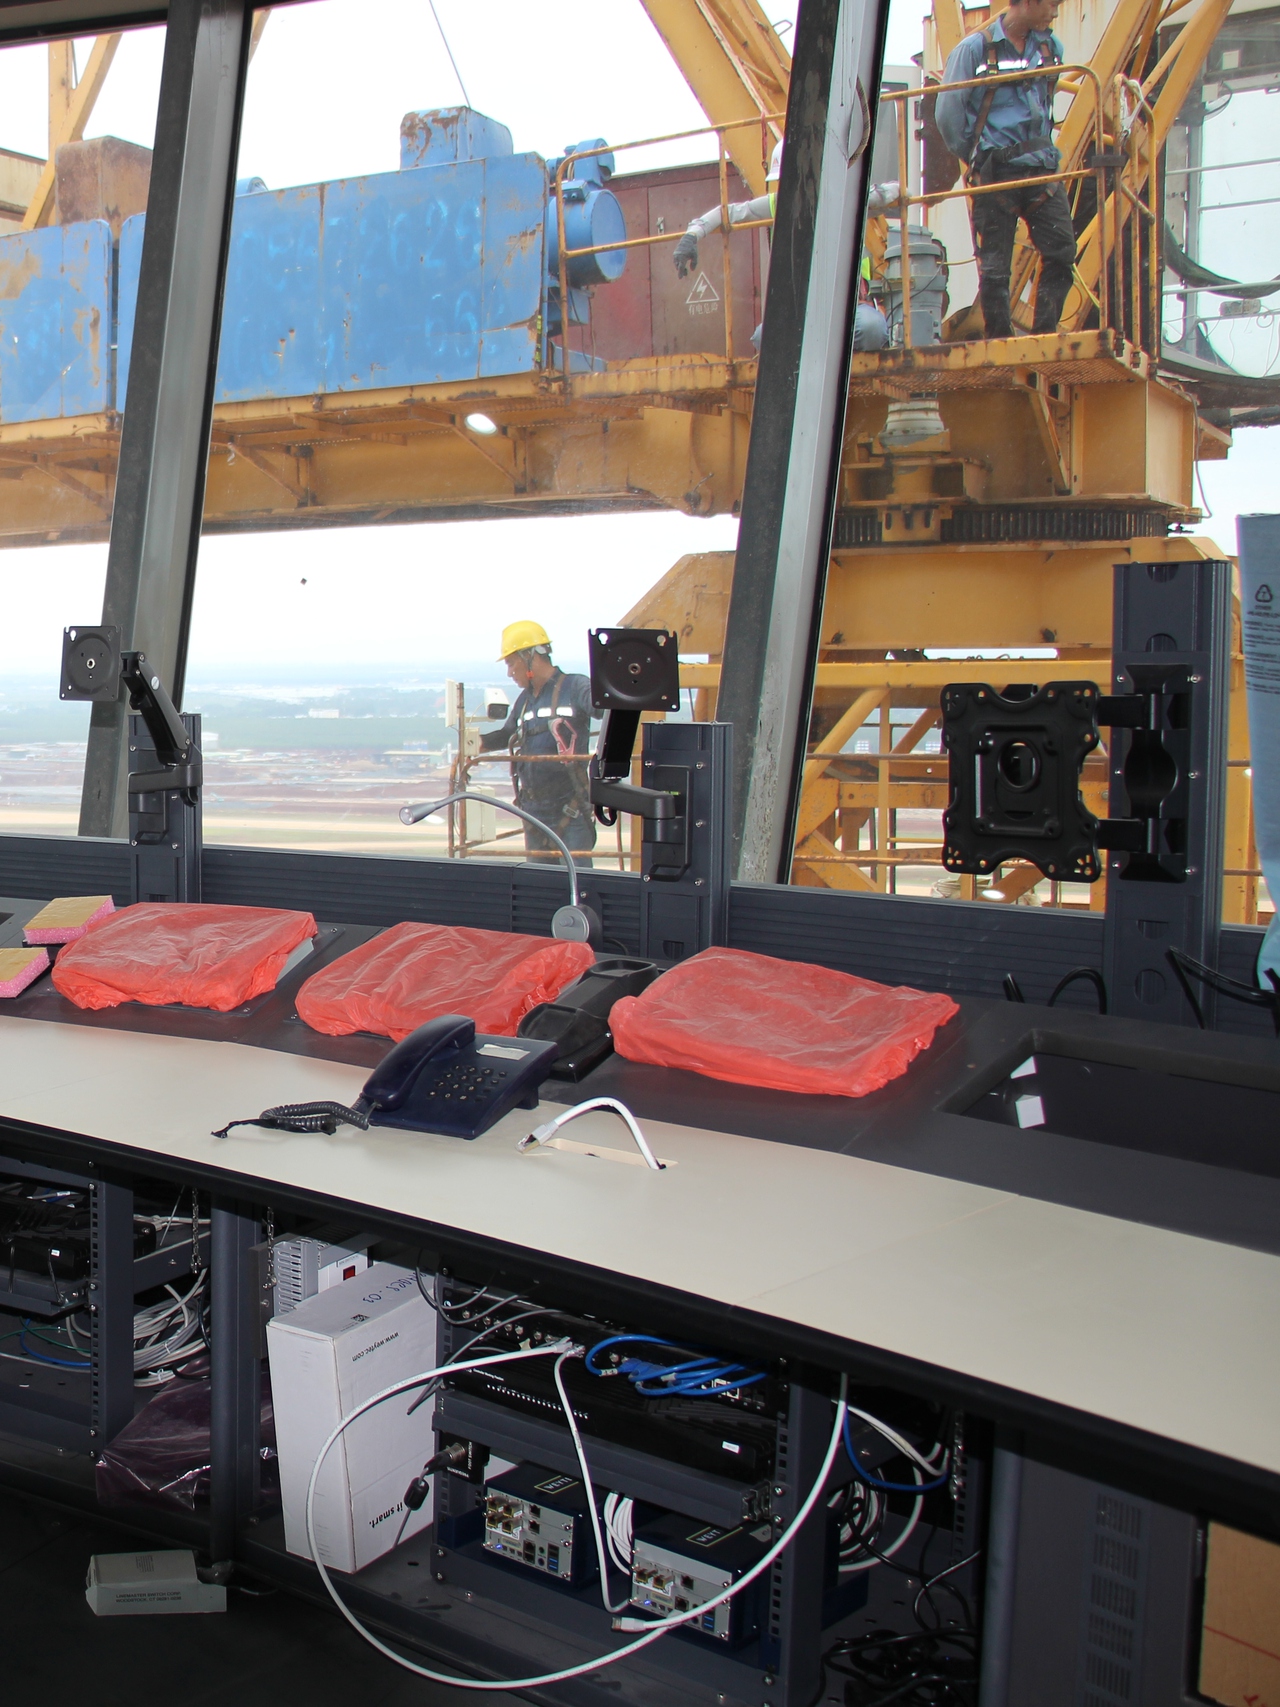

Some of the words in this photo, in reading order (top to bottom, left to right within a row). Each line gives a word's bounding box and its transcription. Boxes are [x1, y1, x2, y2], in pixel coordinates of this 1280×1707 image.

[352, 1332, 399, 1362] www.weytec.com
[369, 1507, 394, 1528] smart.
[396, 1502, 403, 1512] it
